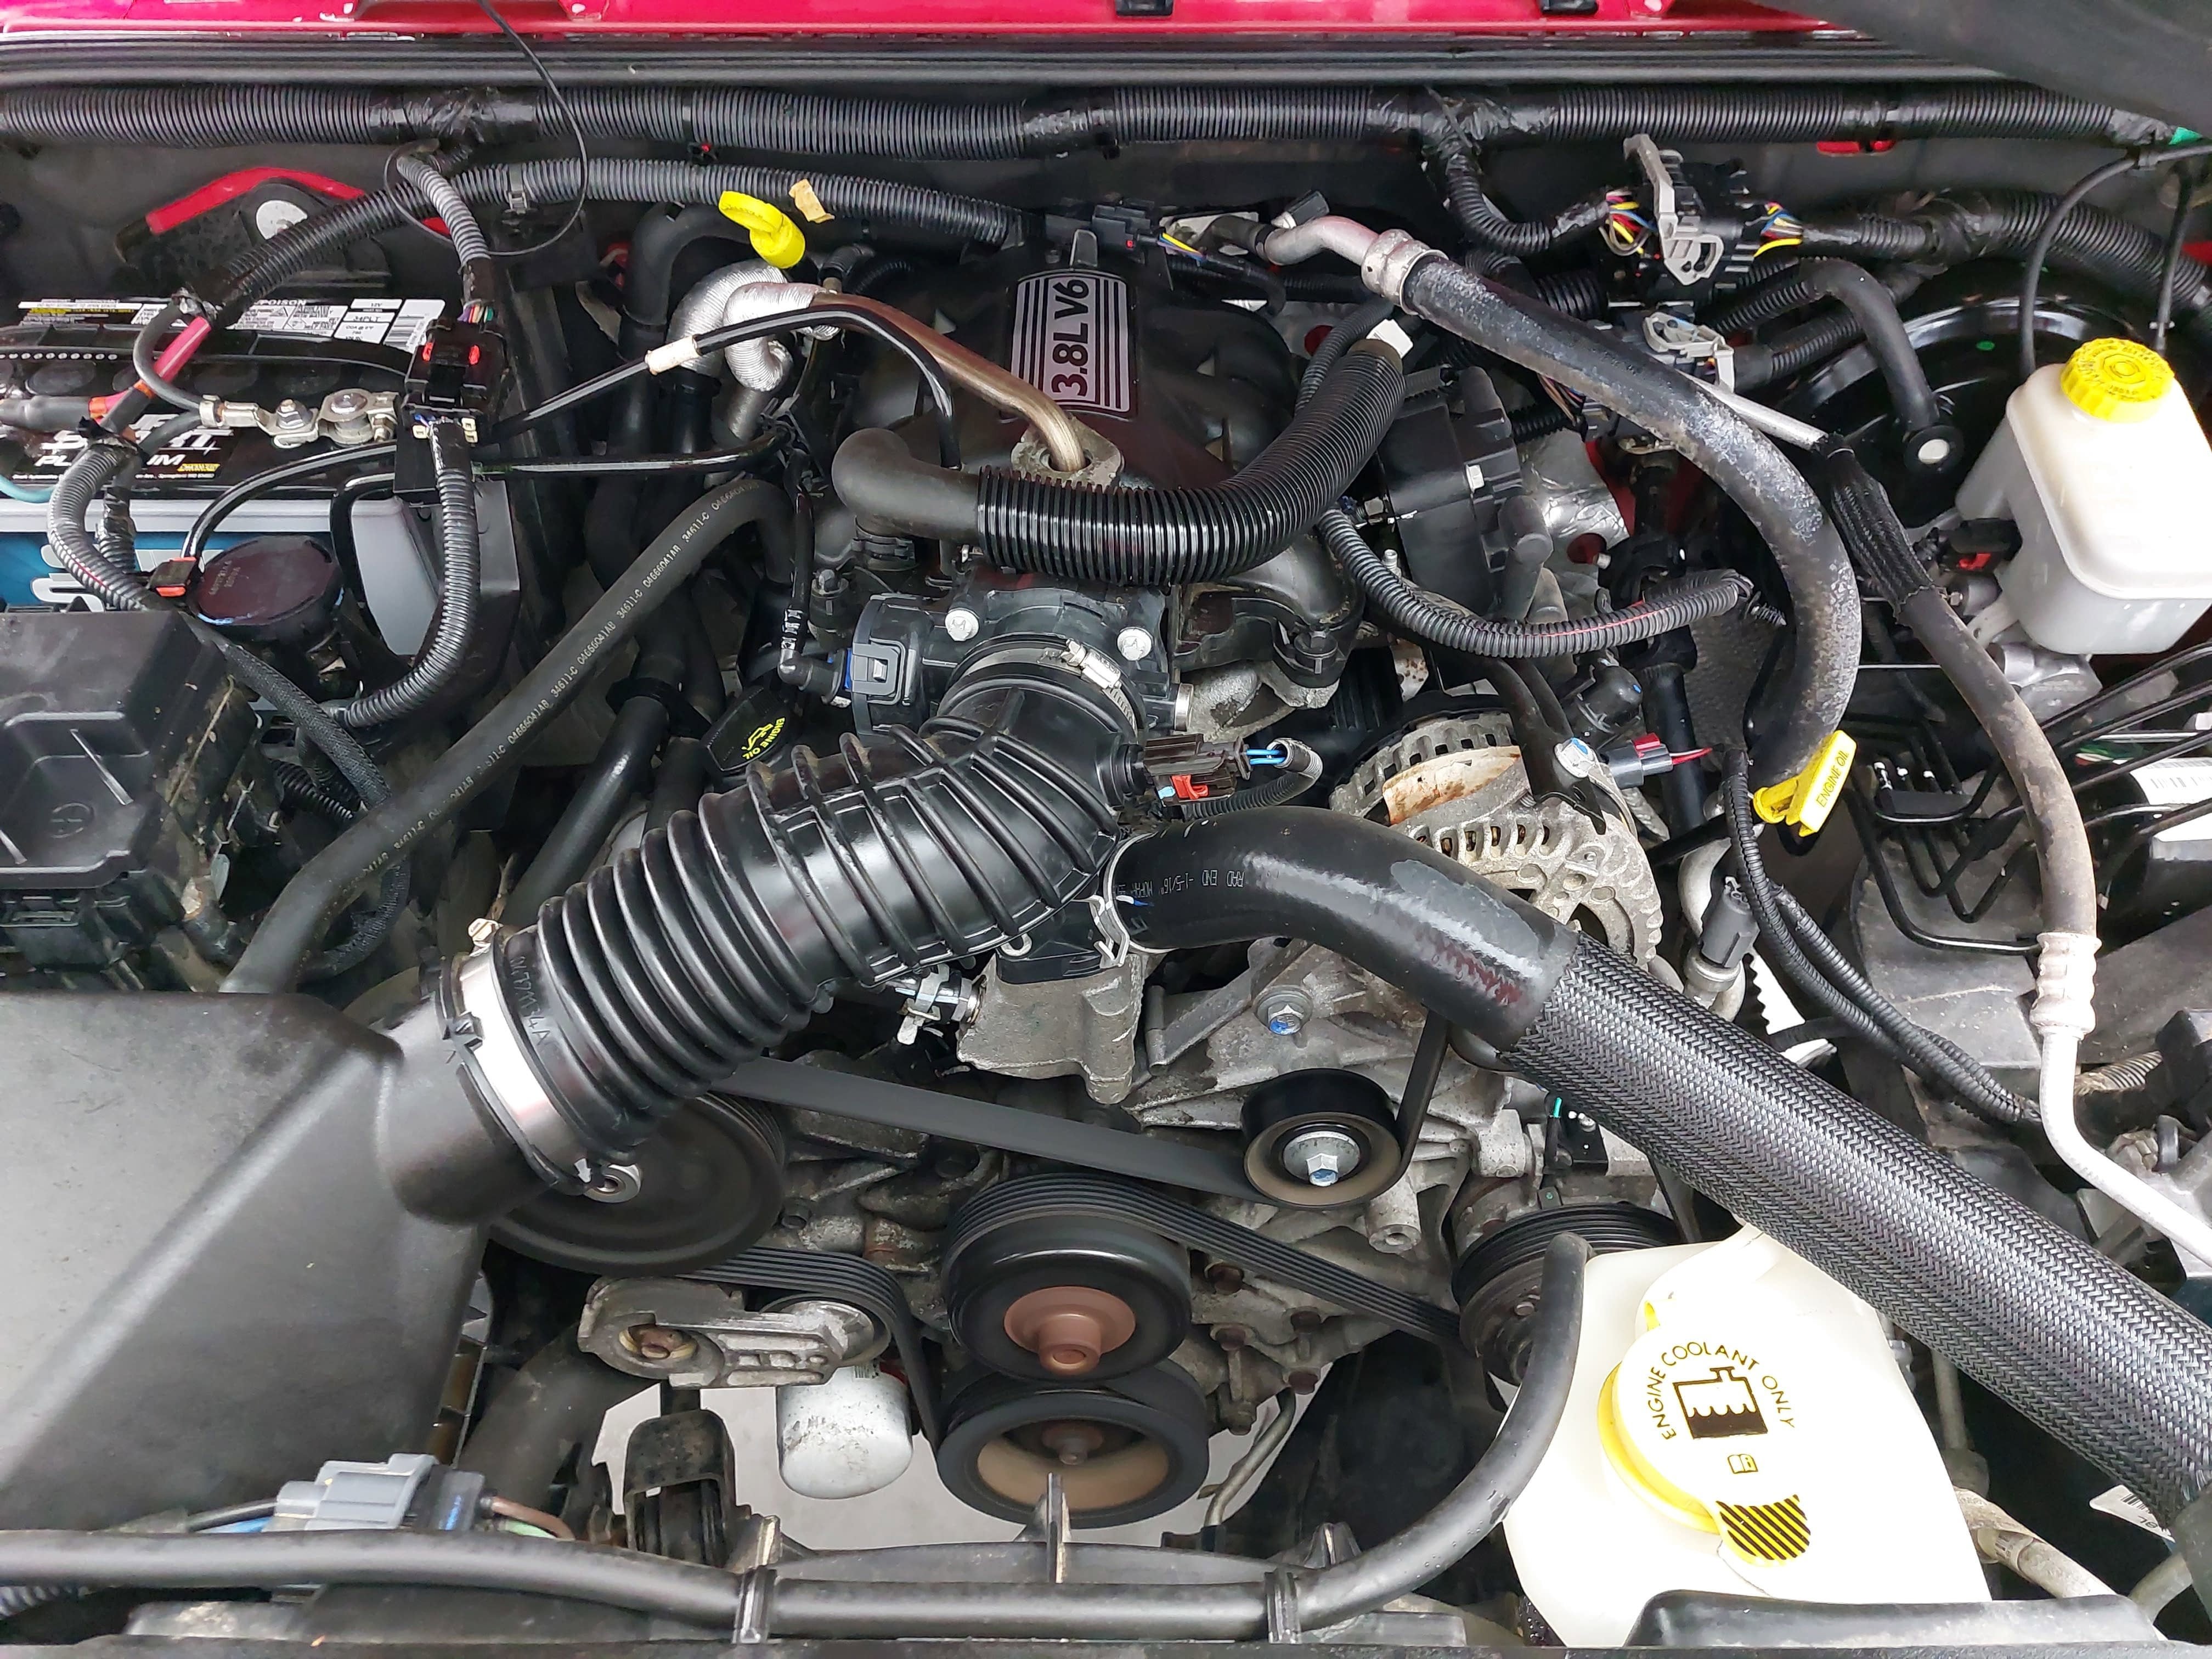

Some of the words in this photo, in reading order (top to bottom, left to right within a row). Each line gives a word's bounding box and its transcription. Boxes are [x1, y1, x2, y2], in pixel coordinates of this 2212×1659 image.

[1053, 279, 1089, 320] V6
[1051, 323, 1089, 397] 3.8L
[550, 665, 578, 698] 34611-C
[616, 589, 643, 619] 34611-C
[681, 512, 710, 543] 34611-C
[759, 717, 786, 748] ENGINE
[742, 747, 761, 760] OIL
[1816, 765, 1841, 808] ENGINE
[1837, 750, 1849, 767] OIL
[1201, 870, 1217, 887] END
[1227, 871, 1245, 888] RAD
[1661, 1341, 1760, 1370] COOLANT
[1647, 1367, 1677, 1440] ENGINE
[1762, 1375, 1795, 1428] ONLY
